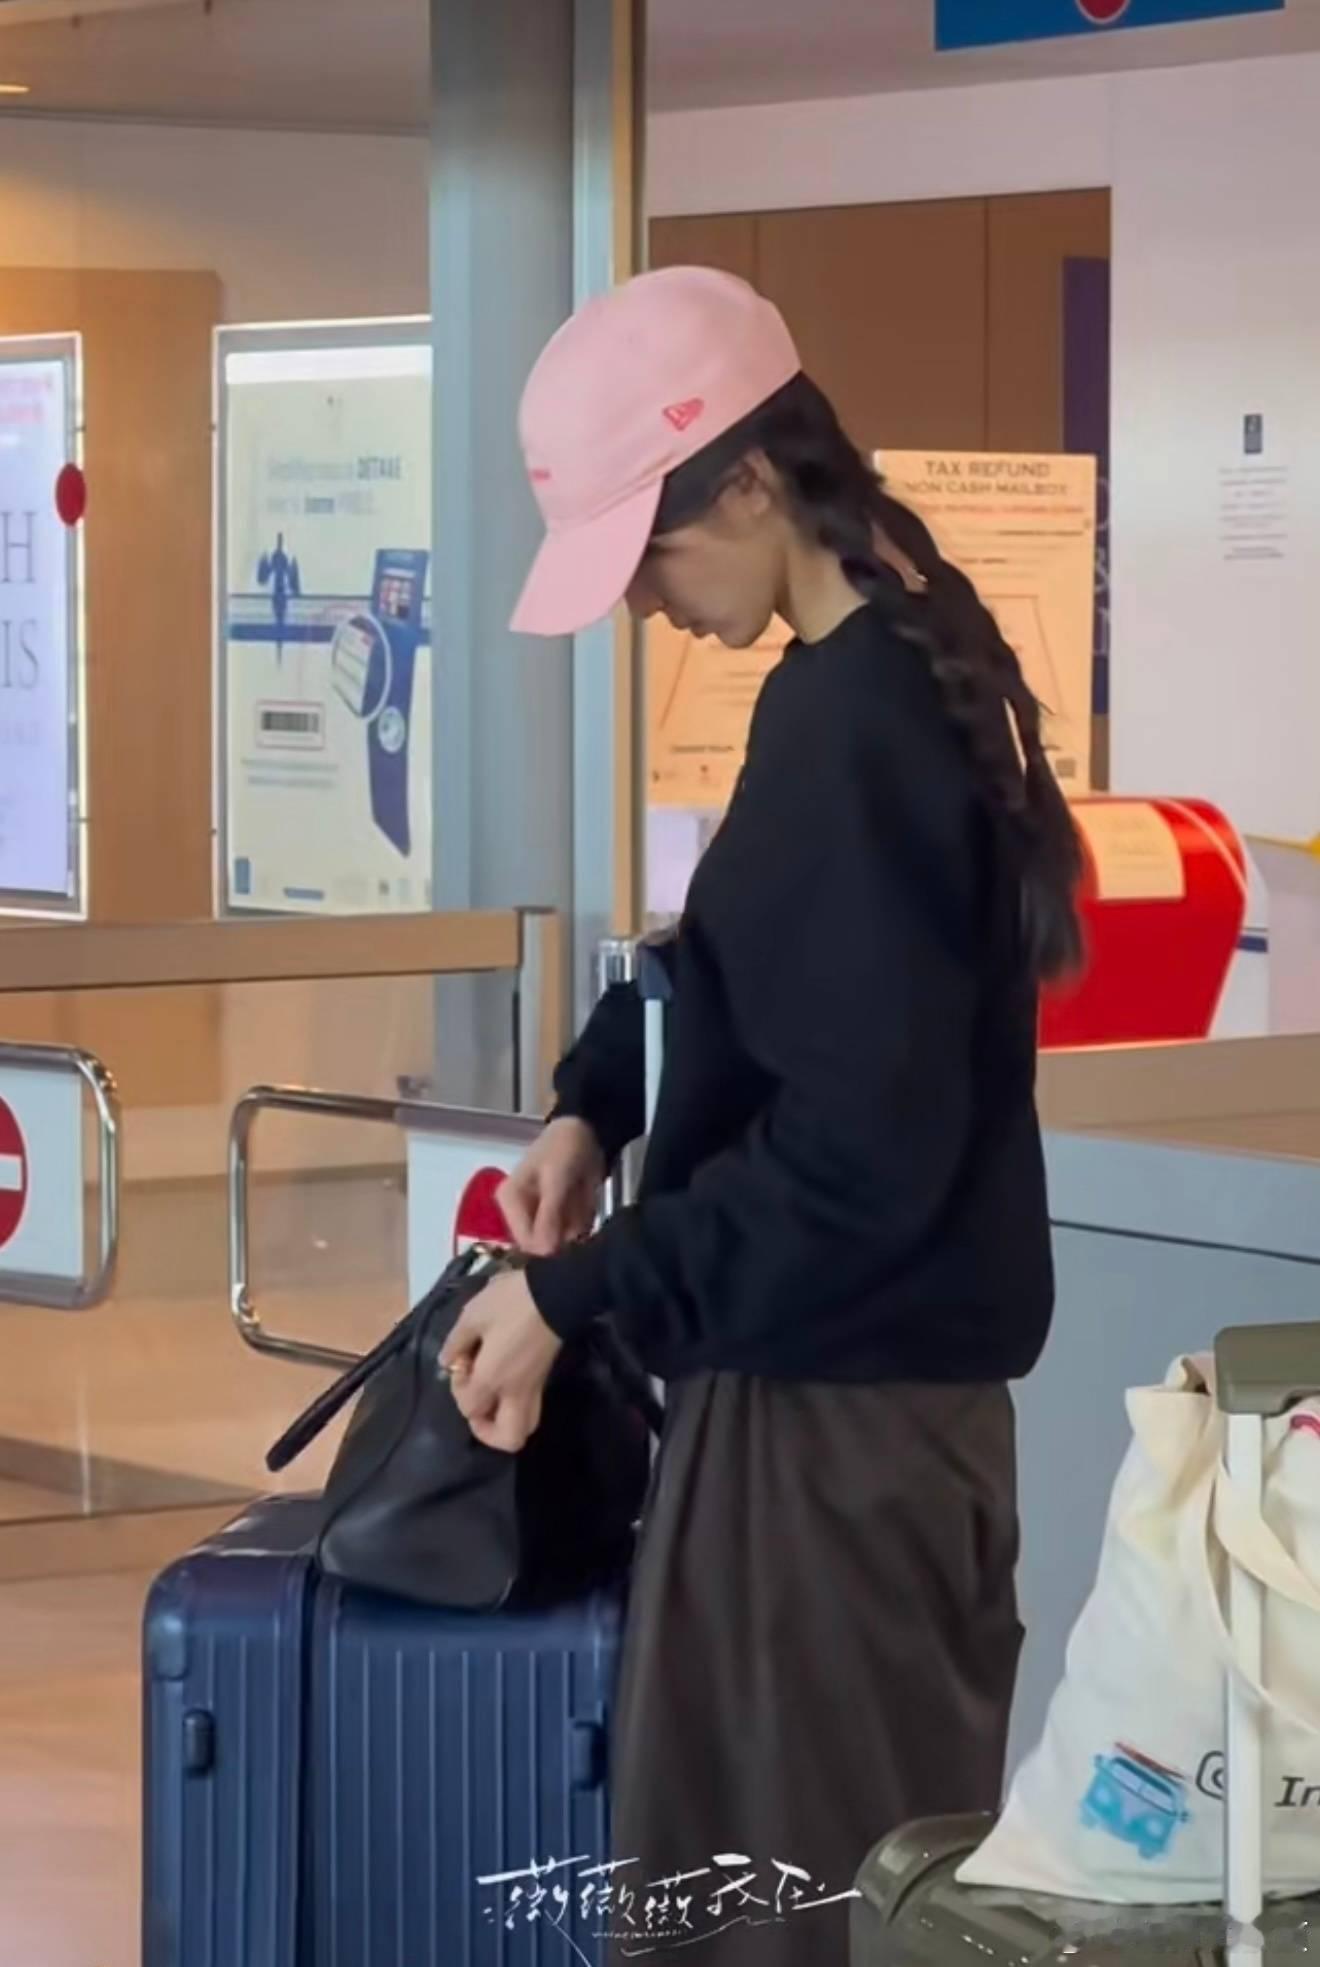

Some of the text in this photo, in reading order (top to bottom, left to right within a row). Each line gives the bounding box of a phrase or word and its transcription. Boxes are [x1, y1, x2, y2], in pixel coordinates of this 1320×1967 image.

[926, 459, 1051, 478] TAX REFUND
[905, 480, 1068, 496] NON CASH MAILBOX
